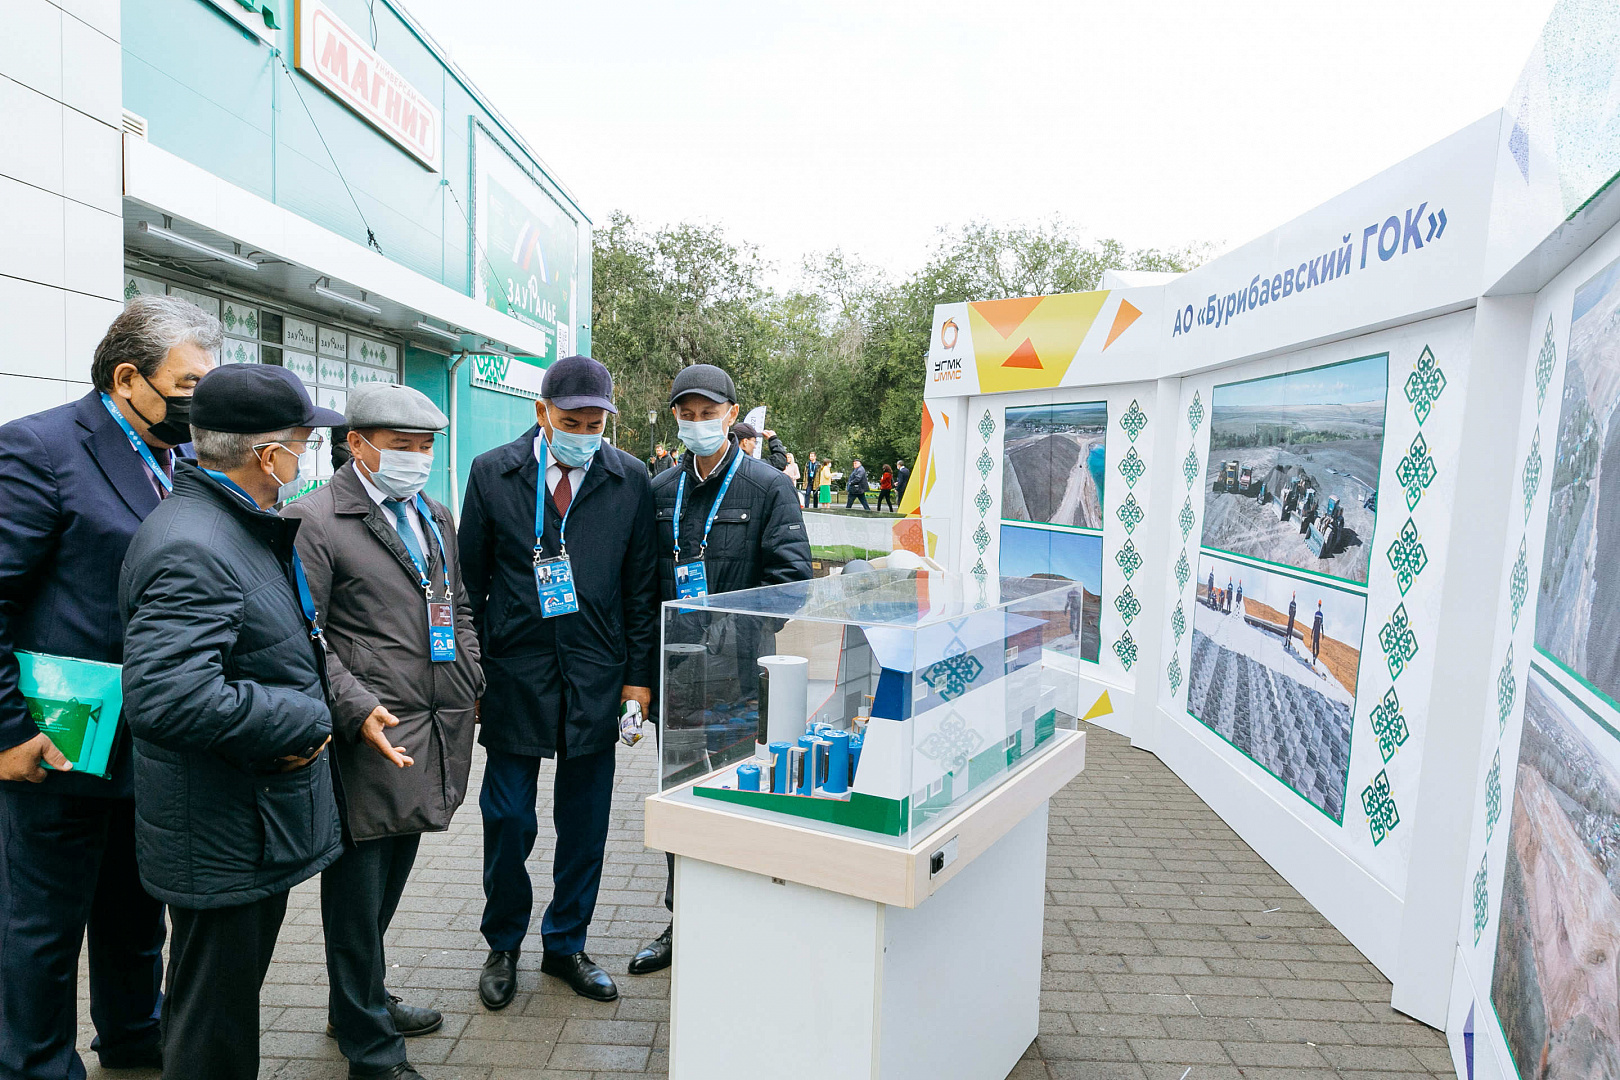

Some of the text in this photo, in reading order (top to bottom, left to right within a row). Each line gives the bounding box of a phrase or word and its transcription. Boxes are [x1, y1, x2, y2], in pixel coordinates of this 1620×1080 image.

[321, 31, 430, 147] МАГНИТ
[375, 59, 416, 102] УНИВЕРСАМ
[1172, 201, 1448, 338] АО «Бурибаевский ГОК»
[507, 274, 557, 325] ЗАУРАЛЬЕ
[934, 358, 962, 372] УГМК
[934, 370, 962, 382] UMMC
